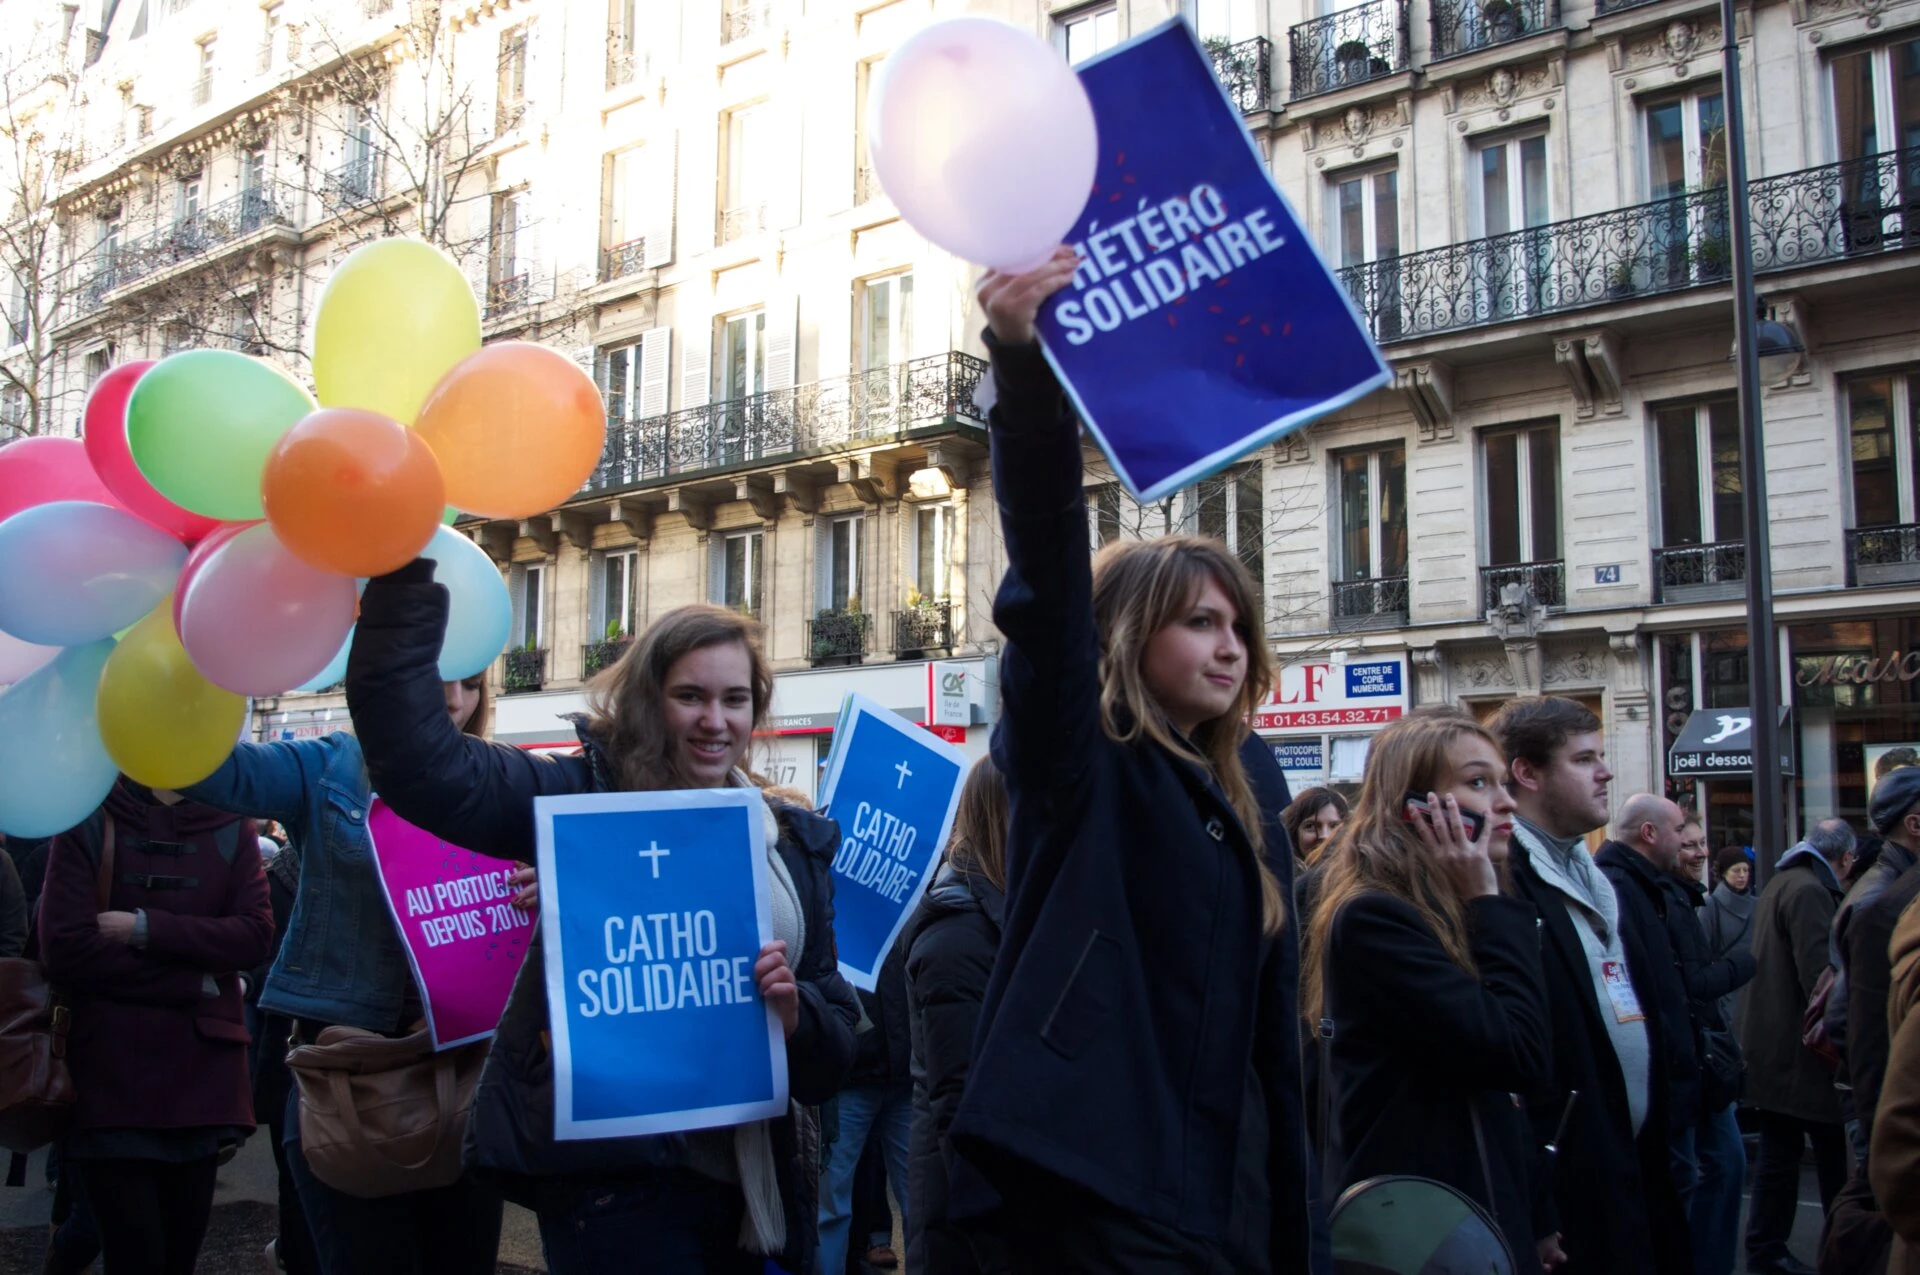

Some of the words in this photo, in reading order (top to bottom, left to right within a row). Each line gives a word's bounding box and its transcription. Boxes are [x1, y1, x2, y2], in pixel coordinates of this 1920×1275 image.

[1071, 183, 1228, 291] HÉTÉRO
[1055, 208, 1286, 346] SOLIDAIRE
[1597, 567, 1616, 582] 74
[1352, 666, 1382, 676] CENTRE
[1382, 665, 1393, 675] DE
[1361, 674, 1384, 684] COPIE
[1352, 683, 1395, 694] NUMERIQUE
[1273, 709, 1389, 727] 01.43.54.32.71
[1674, 752, 1701, 771] joël
[852, 801, 917, 862] CATHO
[830, 837, 918, 904] OLIDAIRE
[406, 886, 434, 917] AU
[420, 910, 487, 948] DEPUIS
[604, 909, 718, 964] CATHO
[577, 956, 753, 1018] SOLIDAIRE
